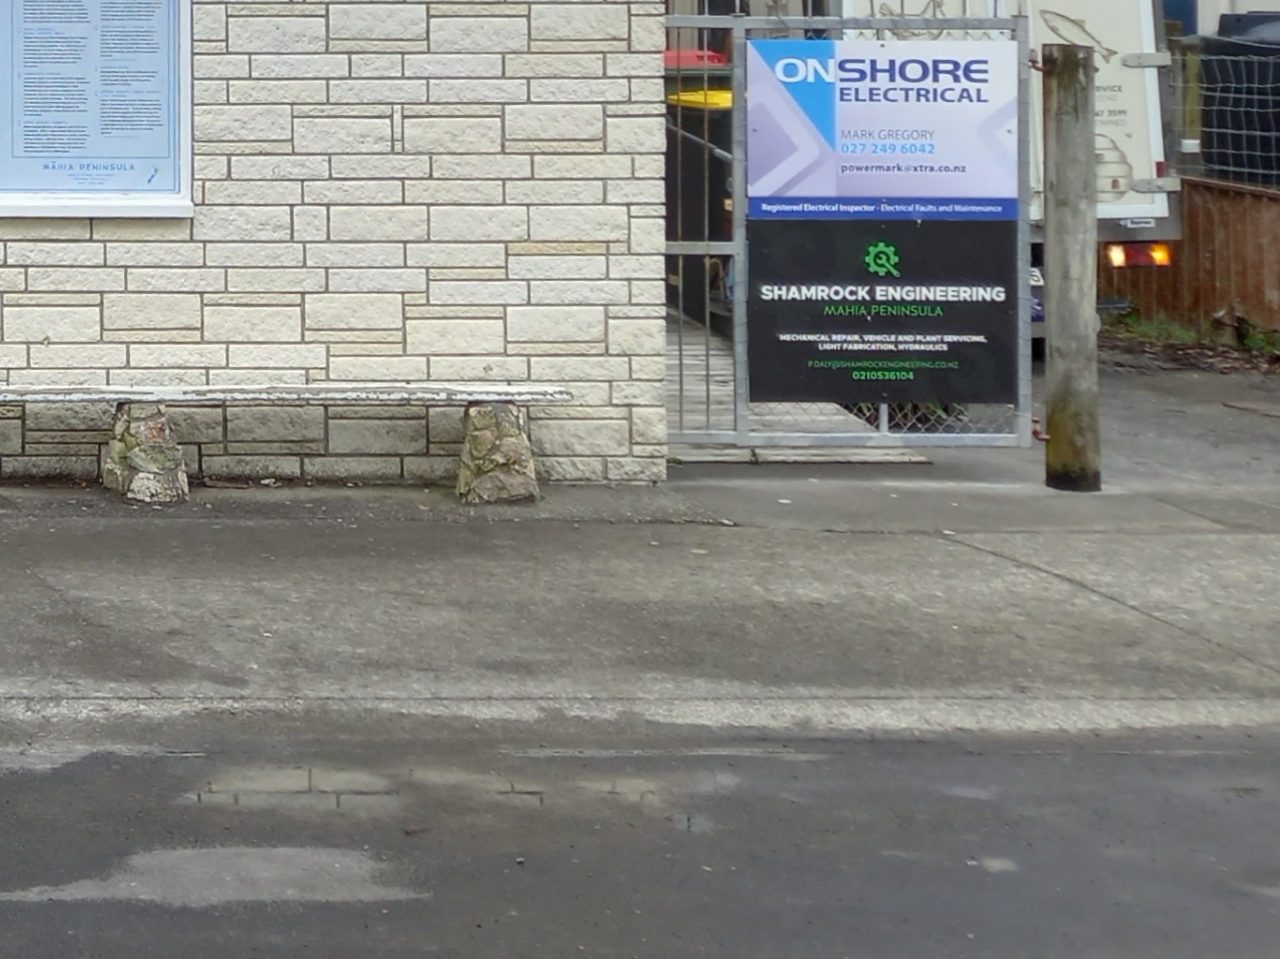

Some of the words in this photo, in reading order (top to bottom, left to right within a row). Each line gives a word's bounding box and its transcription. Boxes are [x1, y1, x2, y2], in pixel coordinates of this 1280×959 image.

[775, 57, 989, 83] ONSHORE
[839, 87, 989, 103] ELECTRICAL
[841, 129, 875, 140] MARK
[878, 129, 935, 140] GREGORY
[841, 143, 866, 154] 027
[871, 143, 897, 154] 249
[900, 143, 935, 154] 6042
[79, 163, 135, 171] PENINSULA
[841, 163, 967, 174] powermark@xtra.co.nz
[762, 203, 802, 213] Registered
[804, 203, 838, 211] Electrical
[840, 203, 875, 213] Inspector
[938, 204, 953, 212] and
[760, 285, 870, 301] SHAMROCK
[875, 285, 1006, 302] ENGINEERING
[823, 305, 867, 316] MAHIA
[871, 305, 943, 316] PENINSULA
[863, 334, 896, 342] VEHICLE
[897, 334, 914, 342] AND
[916, 334, 941, 342] PLANT
[898, 343, 948, 351] HYDRAULICS
[852, 371, 914, 380] 0210536104
